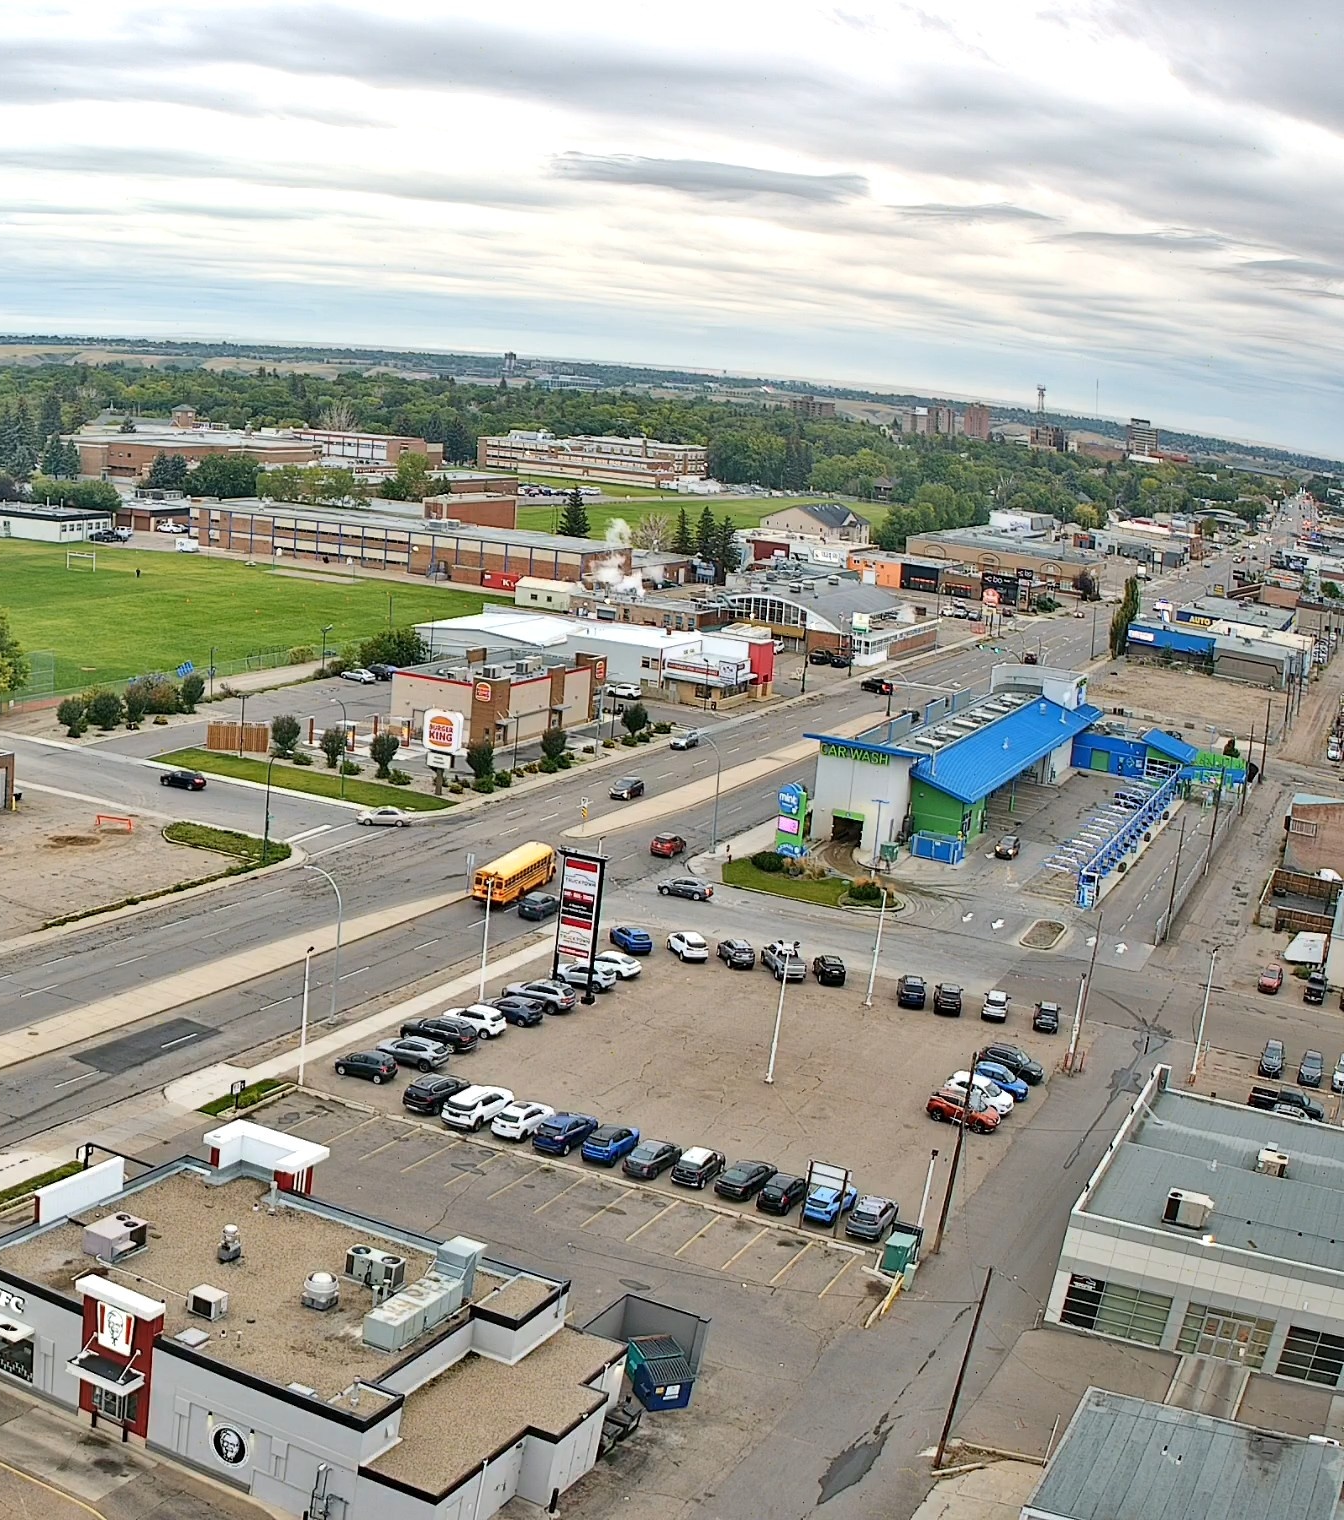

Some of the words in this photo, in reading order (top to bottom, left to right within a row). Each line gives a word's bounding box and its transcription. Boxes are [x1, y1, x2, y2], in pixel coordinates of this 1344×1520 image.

[1189, 615, 1211, 626] AUTO
[429, 723, 453, 734] BURGER
[429, 730, 453, 742] KING
[820, 743, 847, 758] CAR
[849, 748, 890, 766] WASH
[779, 792, 799, 806] mint
